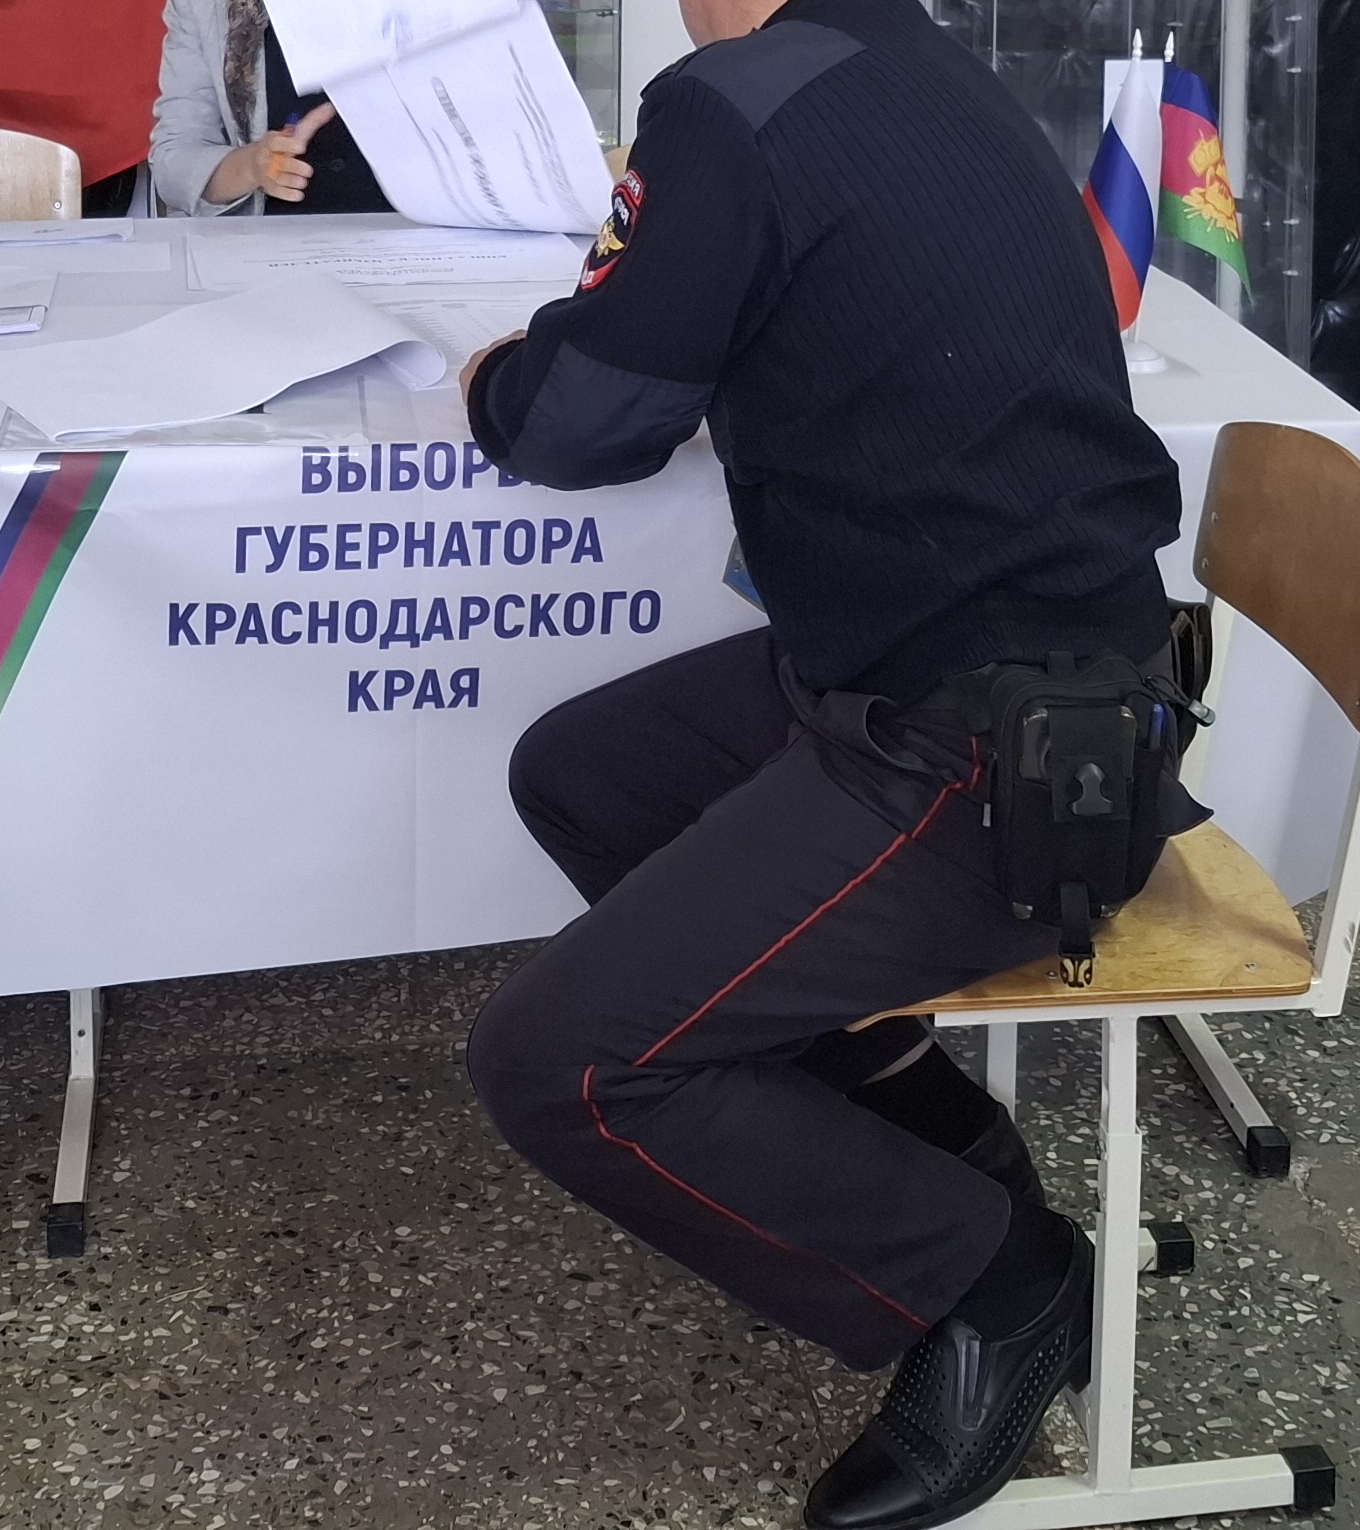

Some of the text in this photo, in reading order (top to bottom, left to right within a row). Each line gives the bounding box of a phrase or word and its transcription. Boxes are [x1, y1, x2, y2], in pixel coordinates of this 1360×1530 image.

[301, 441, 540, 495] ВЫБОР
[235, 517, 604, 574] ГУБЕРНАТОРА
[167, 589, 662, 650] КРАСНОДАРСКОГО
[347, 667, 480, 713] КРАЯ
